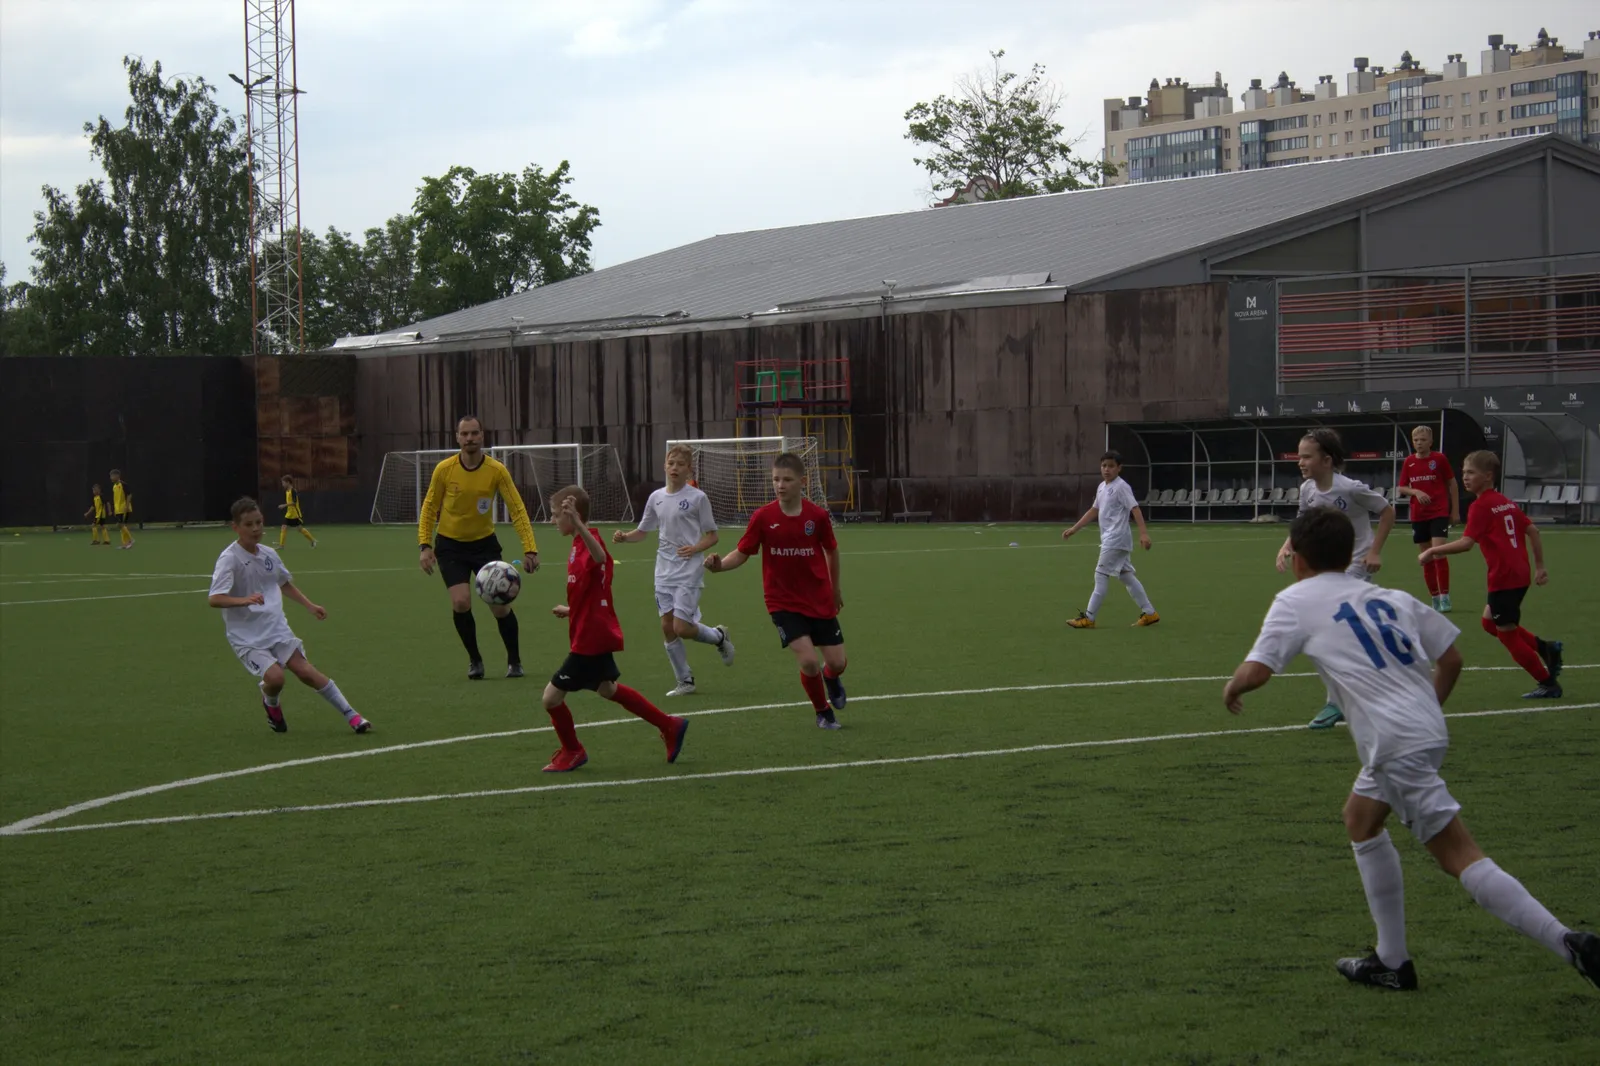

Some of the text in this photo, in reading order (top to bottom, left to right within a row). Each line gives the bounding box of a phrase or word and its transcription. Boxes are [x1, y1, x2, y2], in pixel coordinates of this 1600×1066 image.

[1250, 309, 1268, 317] ARENA
[1385, 450, 1404, 458] LEN
[1504, 514, 1518, 549] 9
[1332, 598, 1416, 670] 16
